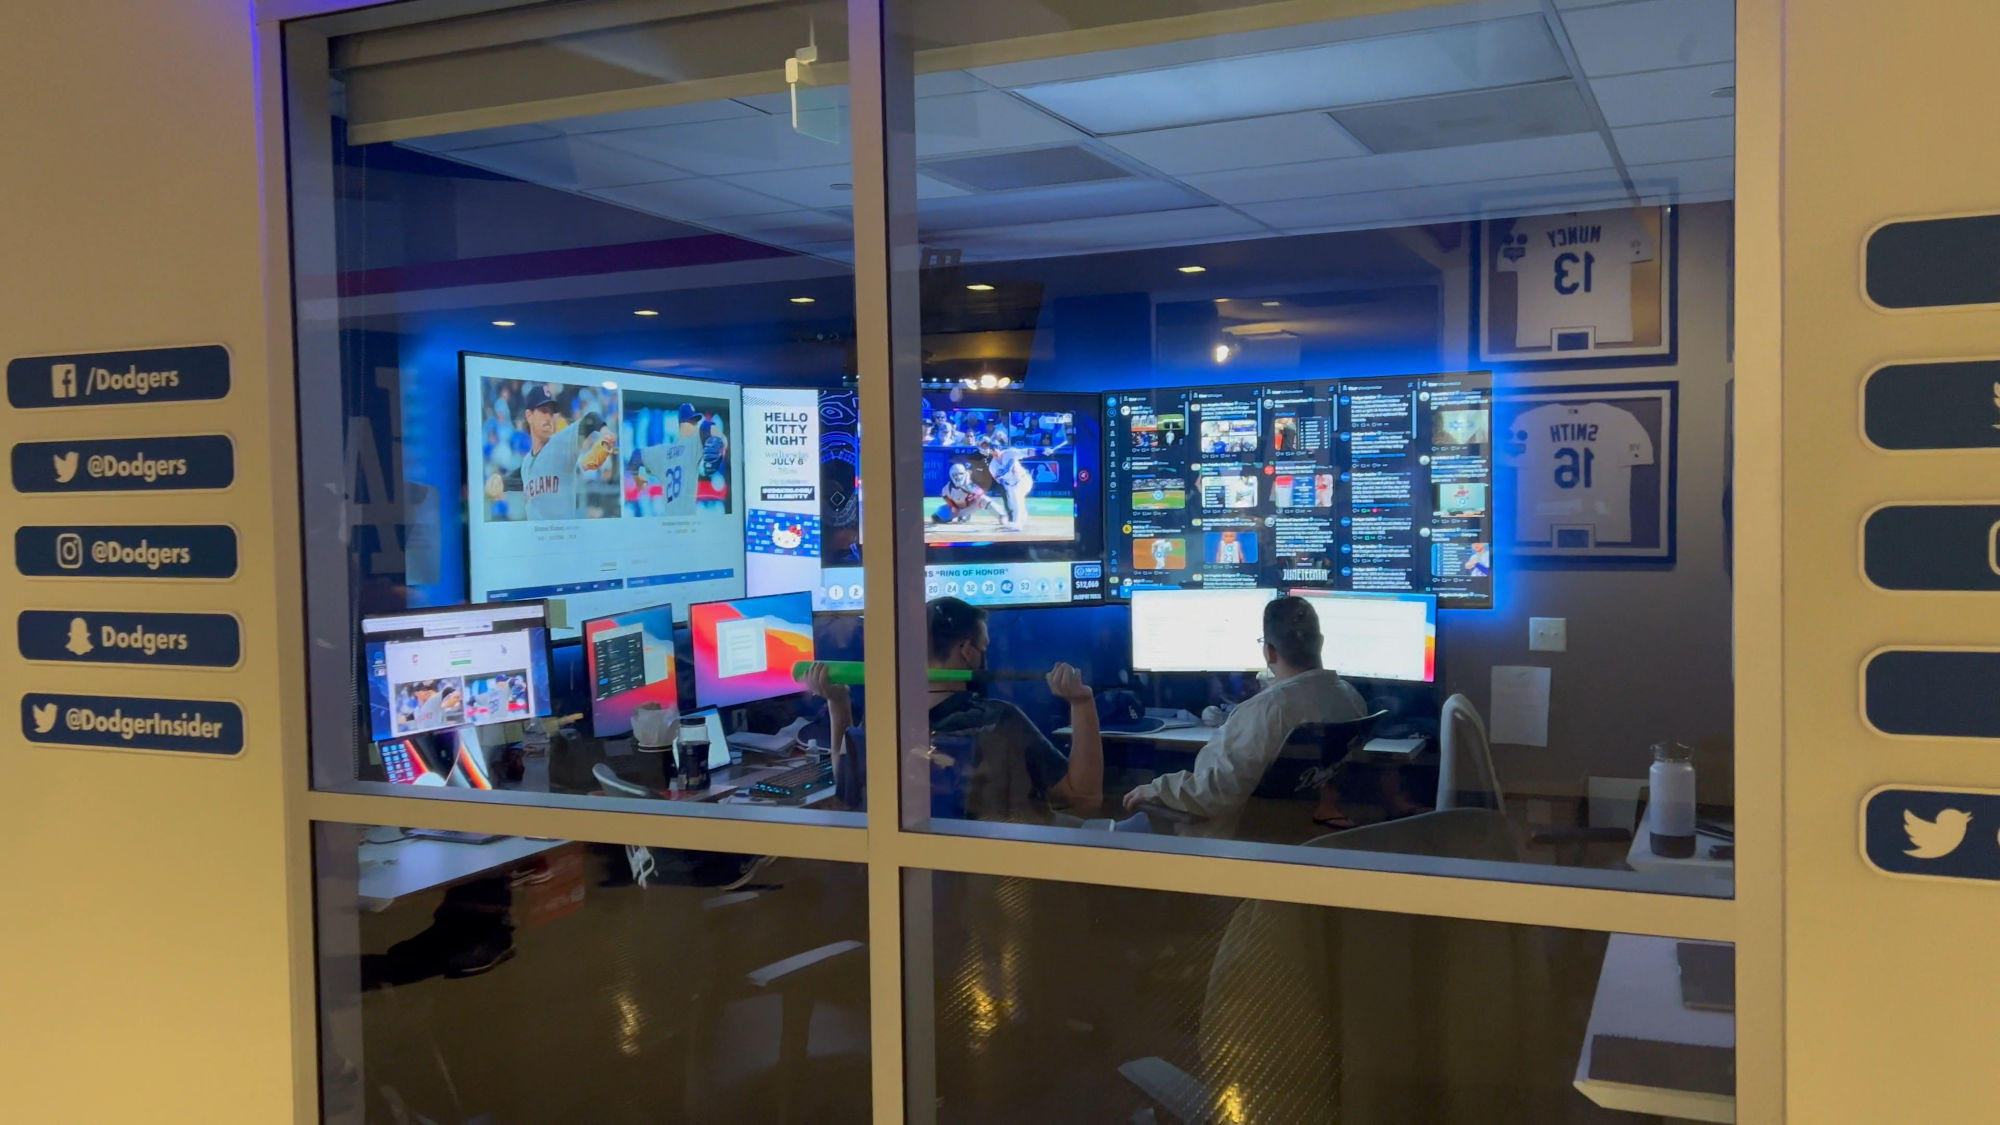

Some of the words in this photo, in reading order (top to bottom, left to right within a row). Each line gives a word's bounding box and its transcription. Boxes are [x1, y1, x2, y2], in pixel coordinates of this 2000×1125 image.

[85, 365, 180, 395] /Dodgers
[764, 412, 808, 422] HELLO
[765, 424, 807, 434] KITTY
[765, 436, 808, 446] NIGHT
[87, 451, 188, 484] @Dodgers
[771, 458, 795, 466] JULY
[797, 458, 804, 466] 6
[666, 465, 682, 503] 28
[91, 540, 191, 569] @Dodgers
[928, 585, 938, 593] 20
[947, 584, 957, 593] 24
[966, 584, 975, 592] 32
[1002, 583, 1012, 591] 42
[1020, 583, 1029, 591] 53
[101, 624, 188, 655] Dodgers
[65, 707, 223, 740] @DodgerInsider
